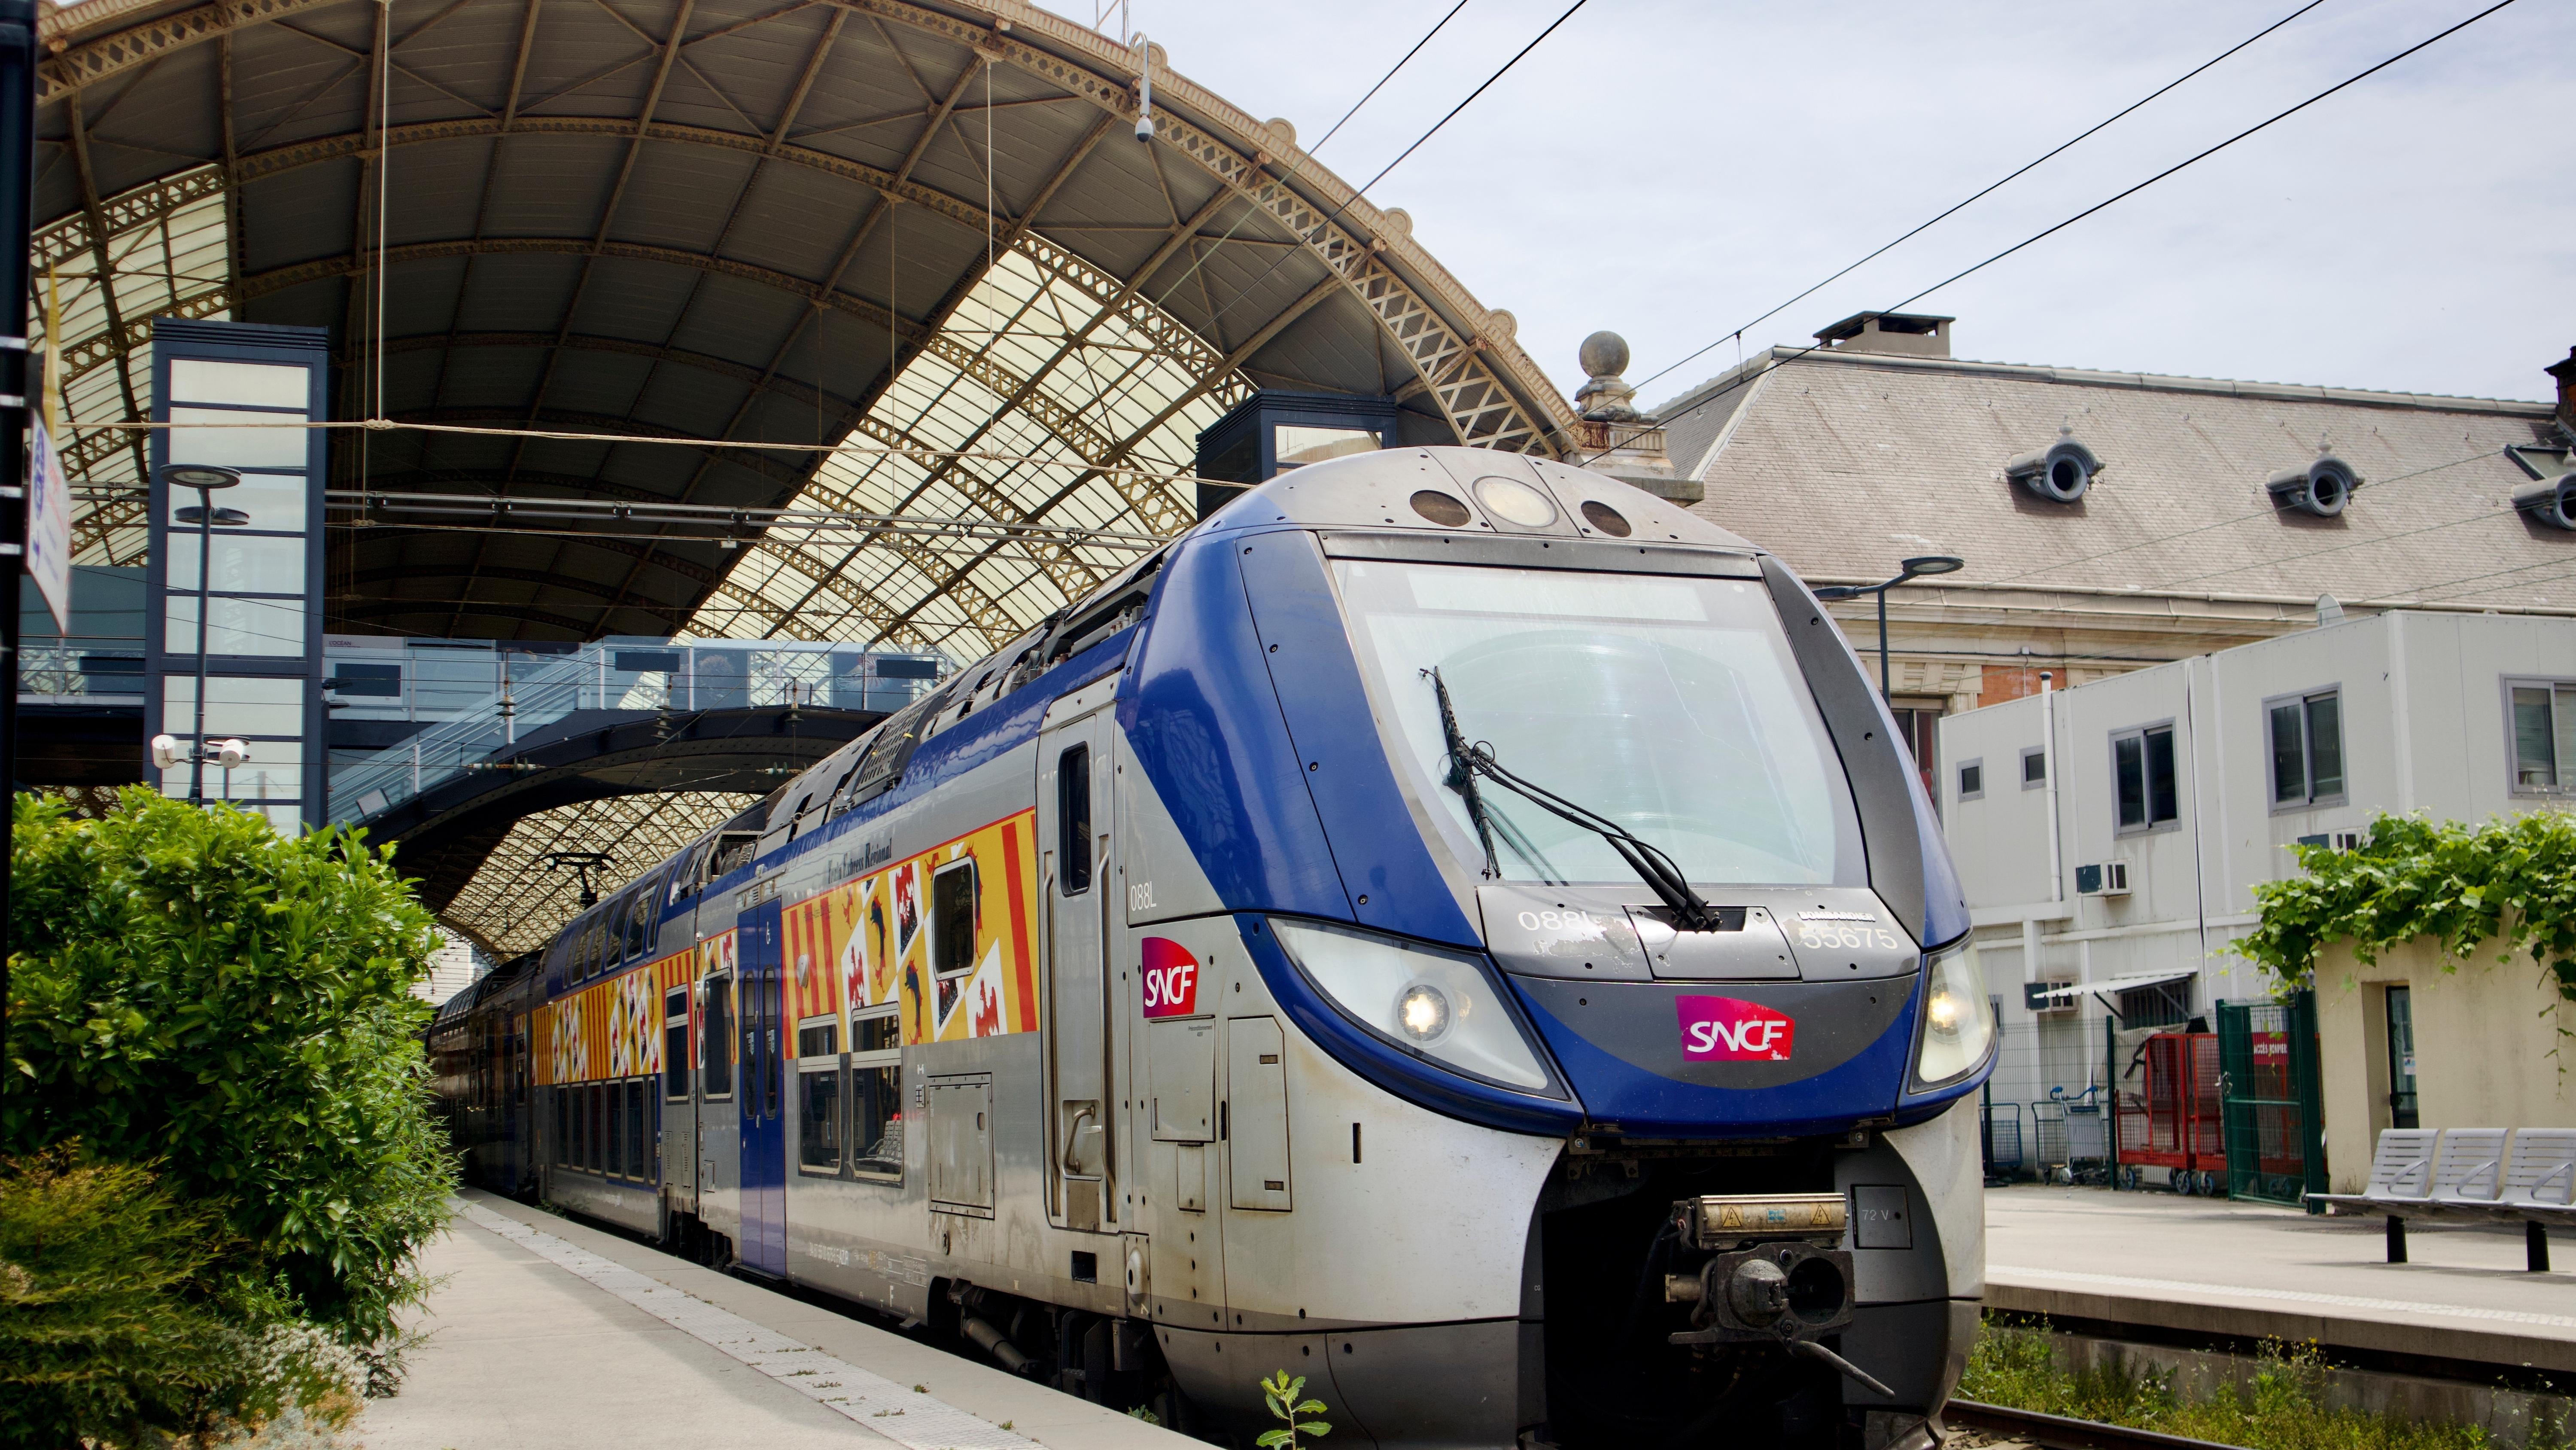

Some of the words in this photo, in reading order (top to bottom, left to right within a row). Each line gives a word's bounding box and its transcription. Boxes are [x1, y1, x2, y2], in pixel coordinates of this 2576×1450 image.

[843, 853, 864, 878] Express
[865, 837, 892, 869] Régional
[1131, 881, 1156, 911] 088L
[1797, 911, 1876, 922] BOMBARDIER
[1799, 927, 1898, 949] 55675
[1145, 965, 1195, 1008] SNCF
[1686, 1020, 1785, 1054] SNCF
[1862, 1209, 1876, 1221] 72
[1881, 1209, 1889, 1220] V
